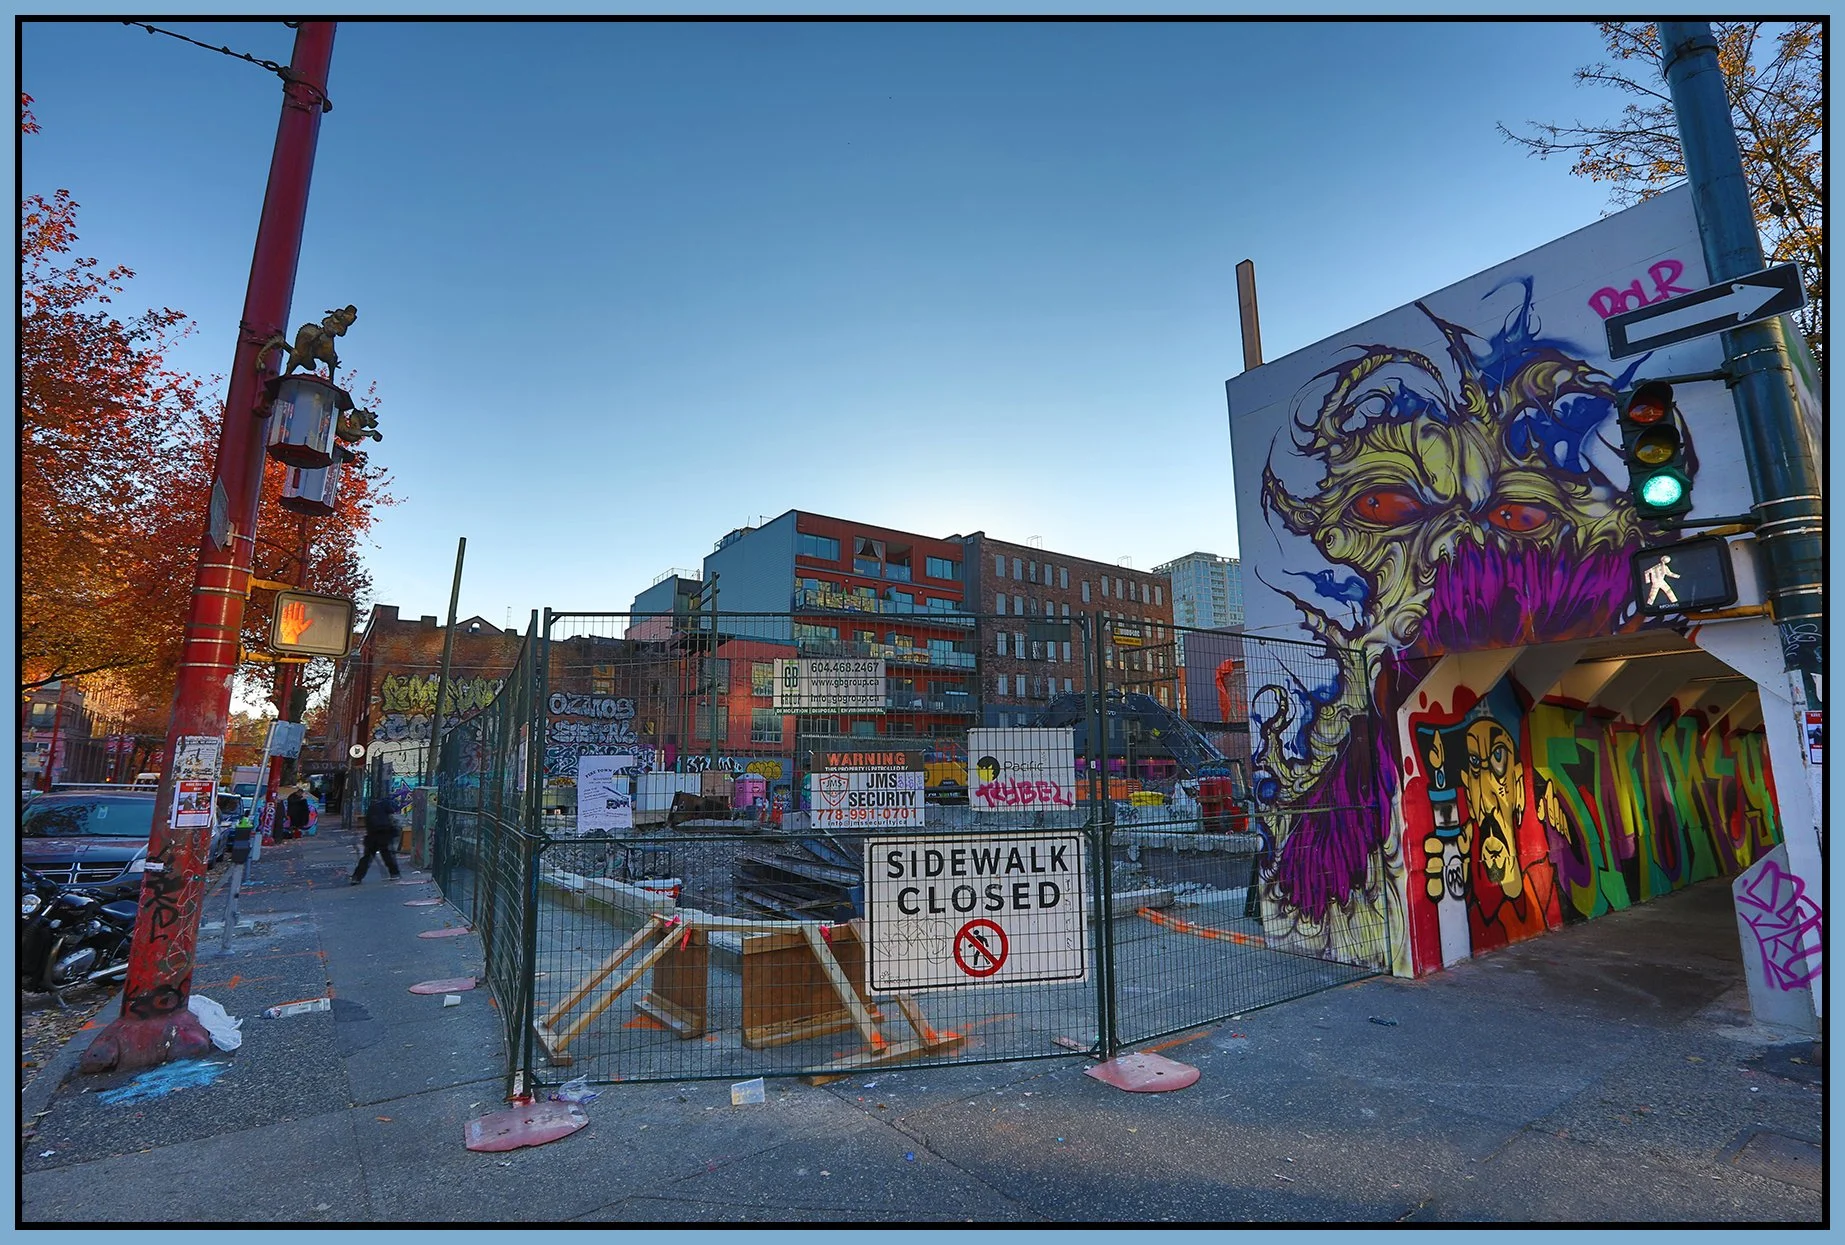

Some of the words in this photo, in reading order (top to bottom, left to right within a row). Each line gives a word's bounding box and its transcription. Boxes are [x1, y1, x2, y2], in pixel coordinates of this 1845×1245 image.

[811, 662, 879, 673] 604.468.2467
[784, 666, 798, 688] GB
[811, 678, 879, 688] www.gbgroup.ca
[827, 752, 906, 766] WARNING
[826, 779, 842, 788] JMS
[867, 773, 898, 788] JMS
[849, 791, 915, 807] SECURITY
[817, 808, 916, 820] 778-991-0701
[887, 844, 1068, 878] SIDEWALK
[898, 881, 1060, 914] CLOSED
